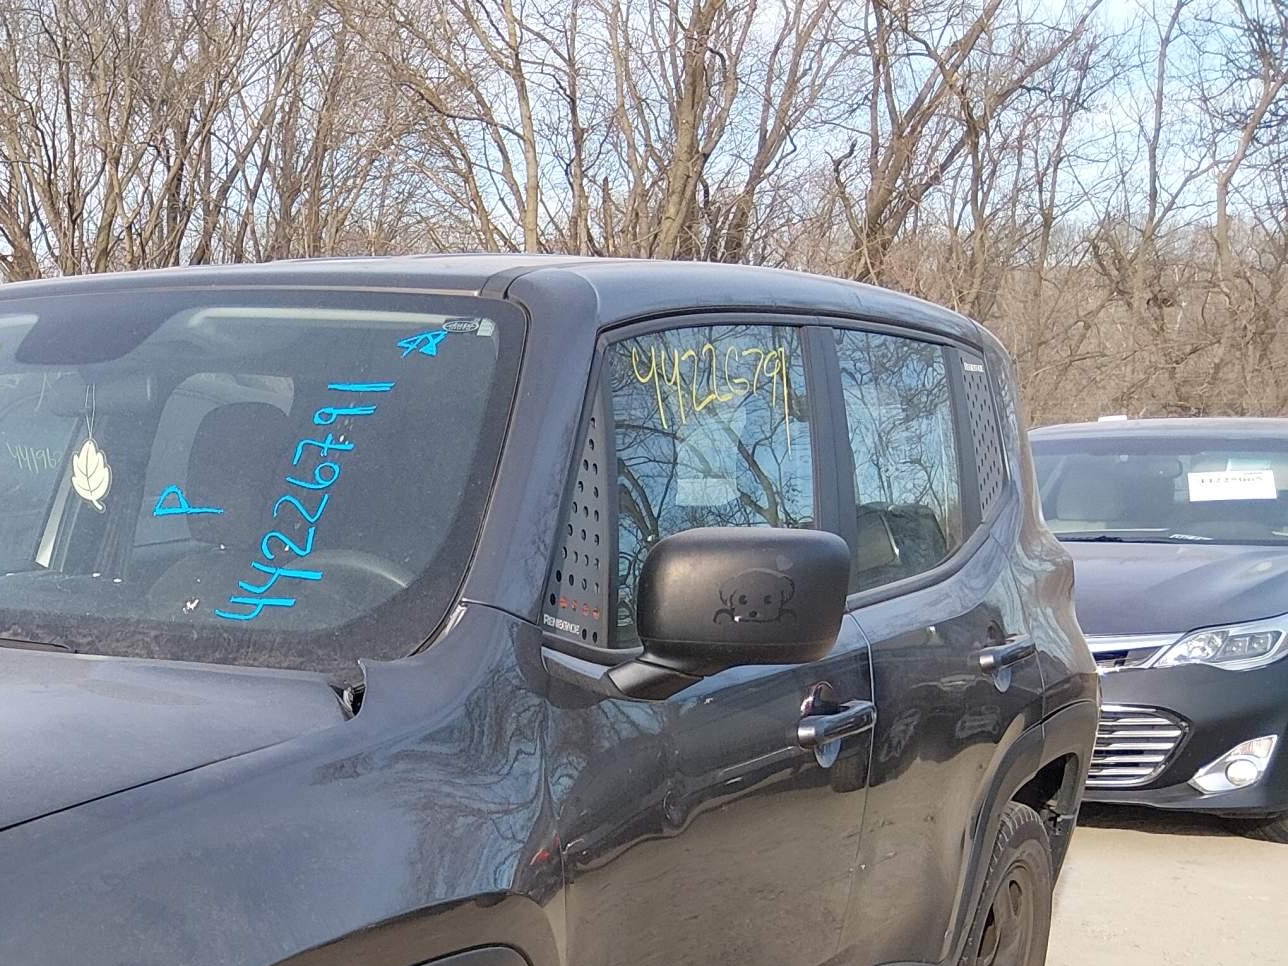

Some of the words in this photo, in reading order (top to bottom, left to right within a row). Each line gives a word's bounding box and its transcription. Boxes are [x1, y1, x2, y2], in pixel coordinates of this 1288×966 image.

[632, 343, 793, 460] 44226791
[153, 485, 224, 516] P
[215, 381, 396, 620] 44226791
